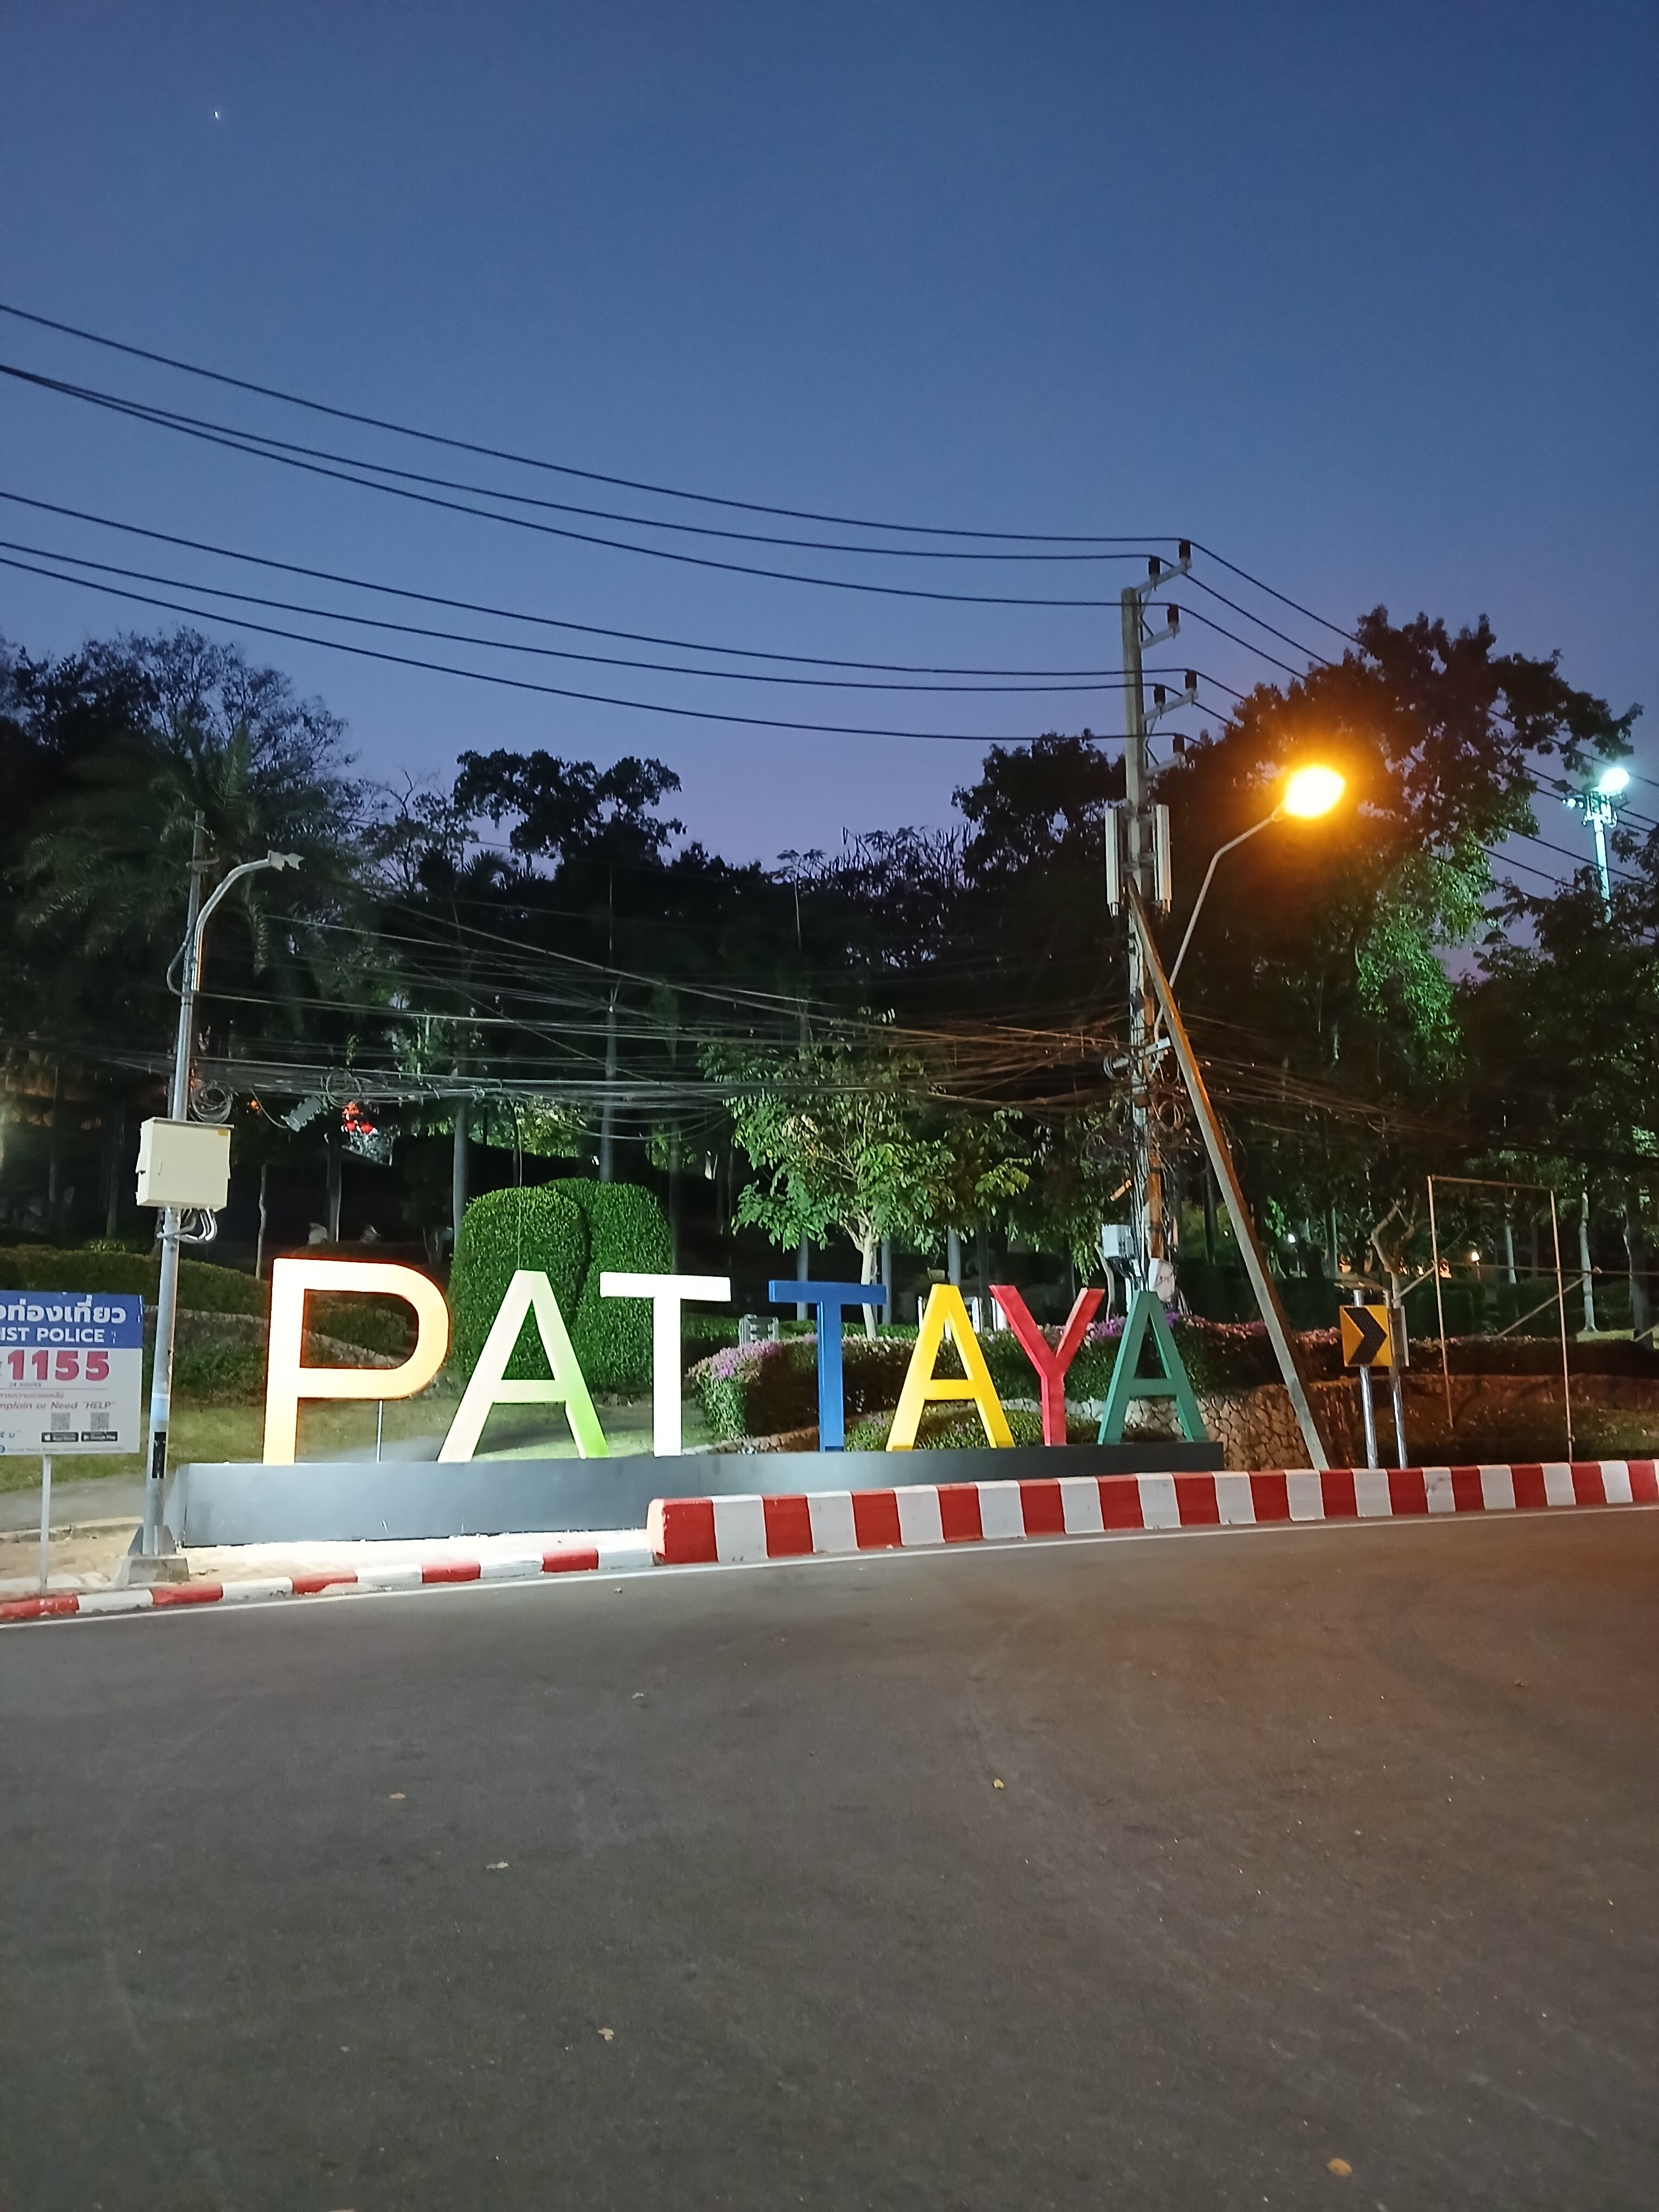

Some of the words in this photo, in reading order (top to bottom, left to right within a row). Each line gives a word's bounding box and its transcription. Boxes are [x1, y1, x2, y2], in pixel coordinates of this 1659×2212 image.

[0, 1327, 30, 1342] IST
[36, 1327, 105, 1343] POLICE
[8, 1349, 110, 1381] 1155
[262, 1258, 1210, 1465] PATTAYA
